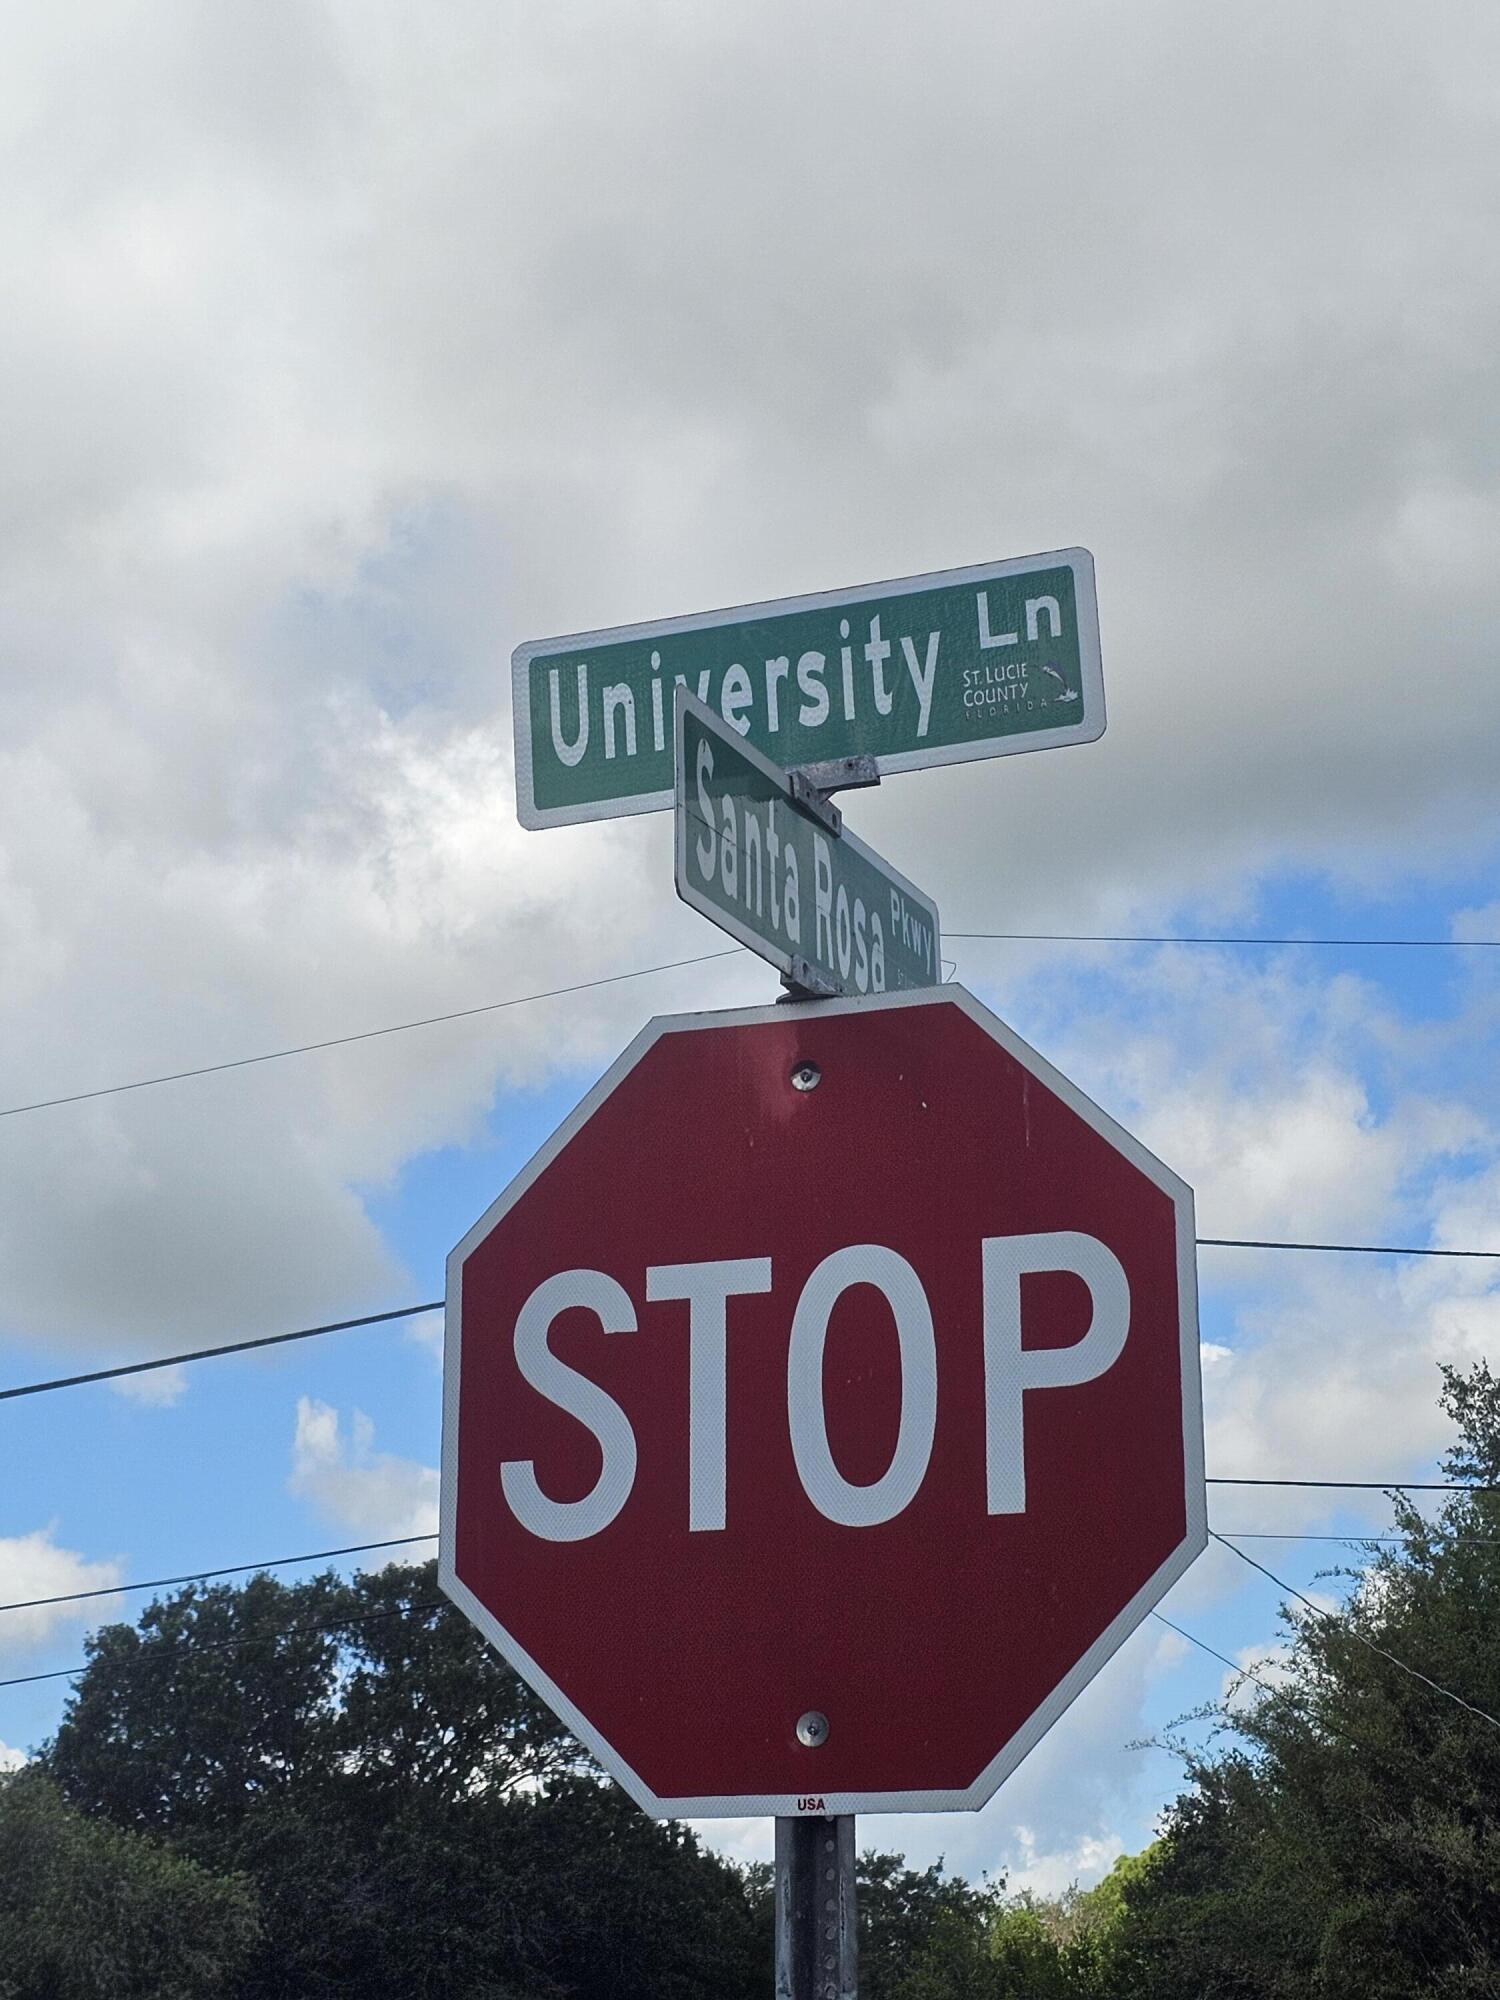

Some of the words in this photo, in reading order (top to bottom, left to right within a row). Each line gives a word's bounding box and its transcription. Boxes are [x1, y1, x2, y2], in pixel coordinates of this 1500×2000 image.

[977, 591, 1062, 649] Ln
[963, 670, 983, 688] ST.
[986, 662, 1029, 683] LUCIE
[963, 682, 1028, 707] COUNTY
[965, 698, 1047, 720] FLORIDA
[696, 738, 800, 944] Santa
[814, 832, 885, 993] Rosa
[890, 888, 932, 976] Pkwy
[500, 1231, 1131, 1542] STOP
[797, 1798, 825, 1811] USA
